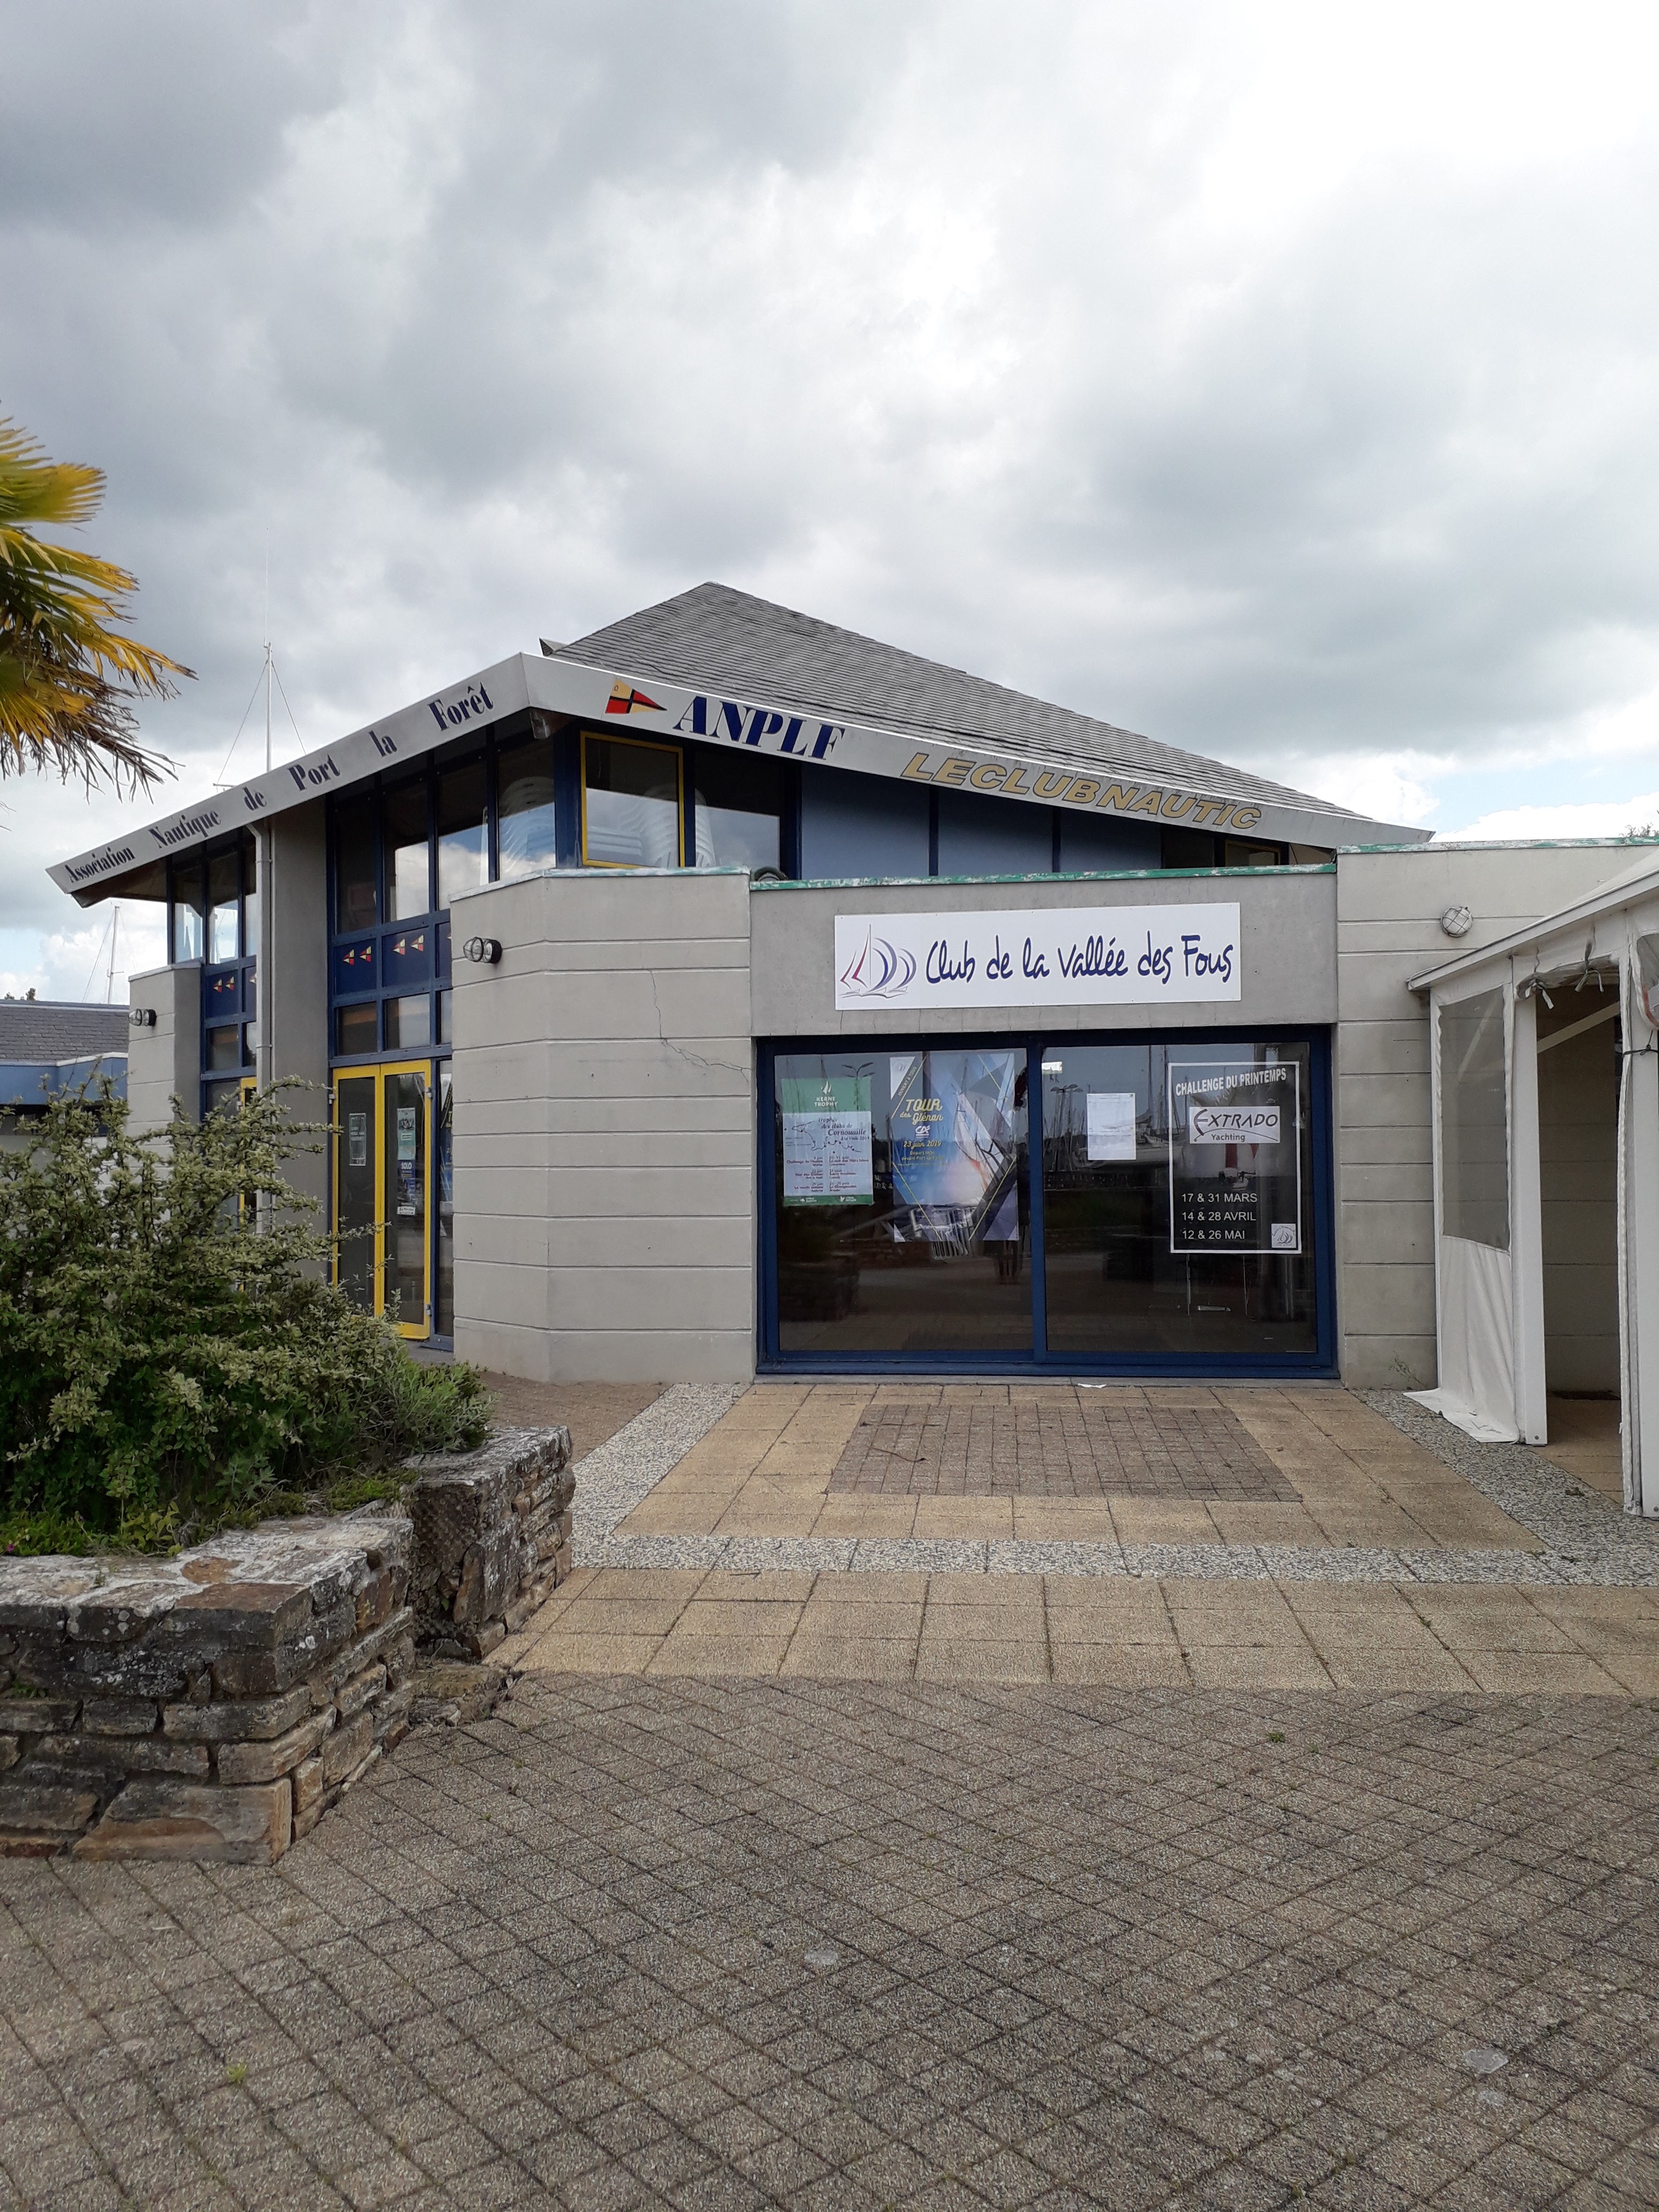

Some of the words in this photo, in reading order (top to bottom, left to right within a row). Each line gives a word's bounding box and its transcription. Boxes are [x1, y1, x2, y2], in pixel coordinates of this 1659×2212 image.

[672, 696, 846, 760] ANPLF
[64, 847, 135, 884] Association
[148, 809, 221, 849] Nautique
[242, 786, 267, 812] de
[287, 753, 342, 793] Port
[368, 730, 398, 758] la
[428, 681, 494, 731] Forêt
[925, 940, 975, 985] Club
[986, 935, 1013, 981] de
[1022, 937, 1050, 978] la
[1137, 930, 1173, 985] des
[1180, 935, 1234, 984] Fous
[1176, 1077, 1224, 1096] CHALLENGE
[1226, 1074, 1238, 1089] DU
[1239, 1067, 1287, 1087] PRINTEMPS
[906, 1098, 943, 1112] TOUR
[912, 1111, 944, 1125] Glénan
[911, 1140, 925, 1149] juin
[1211, 1133, 1246, 1142] Yachting
[1182, 1193, 1194, 1202] 17
[1197, 1193, 1205, 1202] &
[1208, 1193, 1220, 1202] 31
[1224, 1193, 1258, 1202] MARS
[1182, 1212, 1194, 1221] 14
[1197, 1212, 1205, 1221] &
[1208, 1212, 1221, 1221] 28
[1223, 1212, 1257, 1221] AVRIL
[1182, 1230, 1194, 1239] 12
[1198, 1230, 1205, 1239] &
[1208, 1230, 1221, 1239] 26
[1224, 1230, 1245, 1239] MAI
